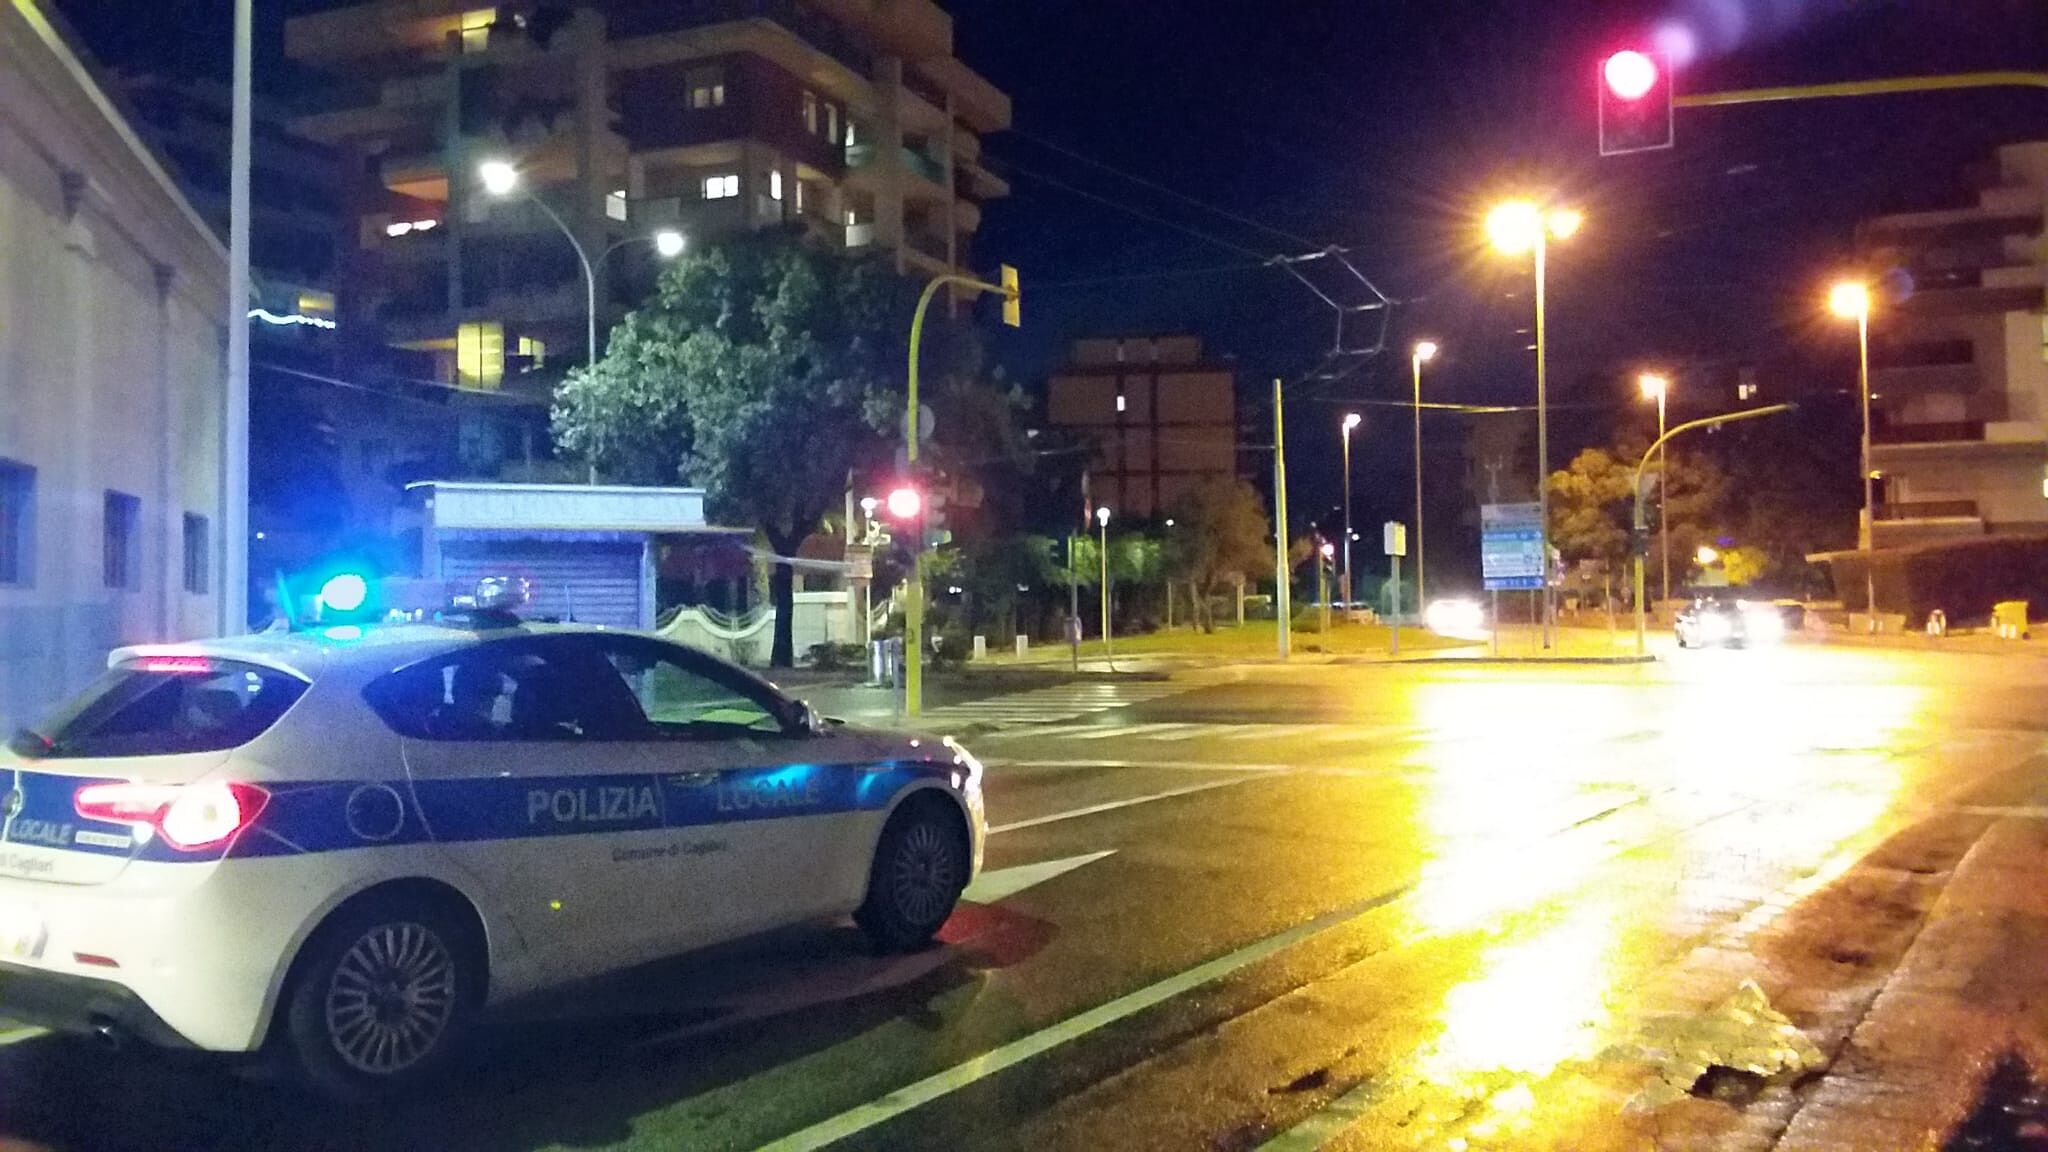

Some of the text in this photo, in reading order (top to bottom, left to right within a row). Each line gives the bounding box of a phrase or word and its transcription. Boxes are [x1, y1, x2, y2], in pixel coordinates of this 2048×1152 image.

[528, 775, 820, 823] POLIZIA LOCALE
[11, 819, 73, 845] LOCALE
